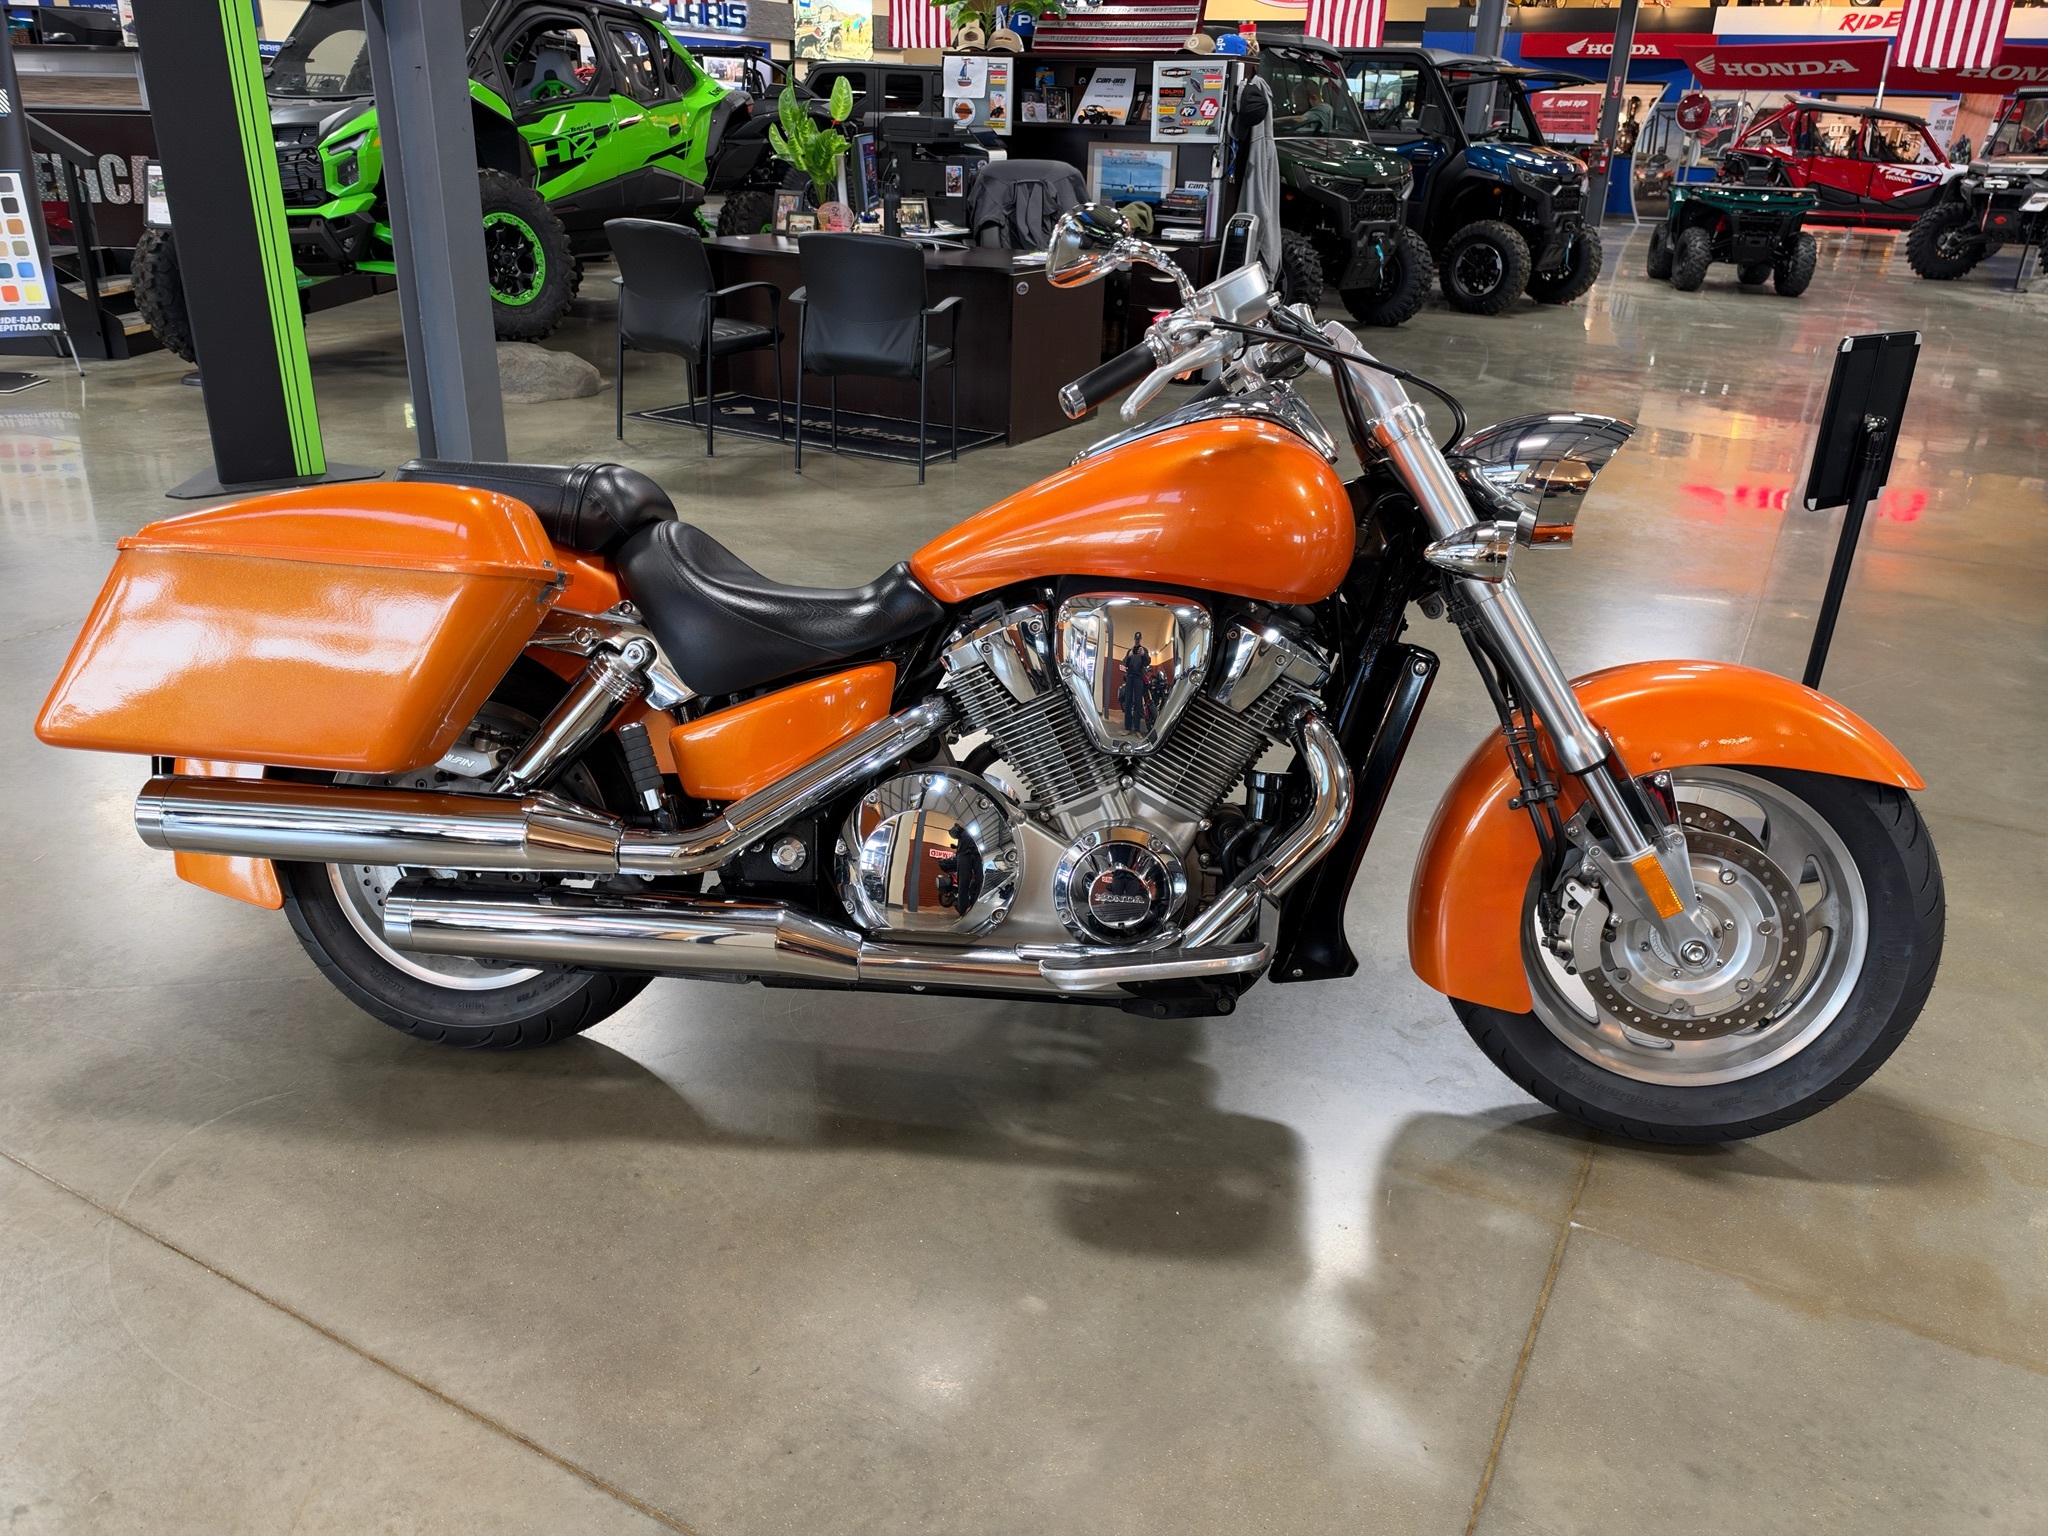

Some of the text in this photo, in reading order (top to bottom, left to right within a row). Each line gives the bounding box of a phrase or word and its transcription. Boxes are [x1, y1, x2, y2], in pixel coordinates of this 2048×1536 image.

[645, 0, 747, 28] LARIS
[1838, 11, 1903, 33] RIDE
[1586, 44, 1660, 55] HODA
[1719, 59, 1859, 77] HONDA
[1956, 65, 2048, 81] HON
[1877, 165, 1940, 182] TALON
[1885, 174, 1912, 184] HONDA
[1094, 893, 1145, 904] HONDA
